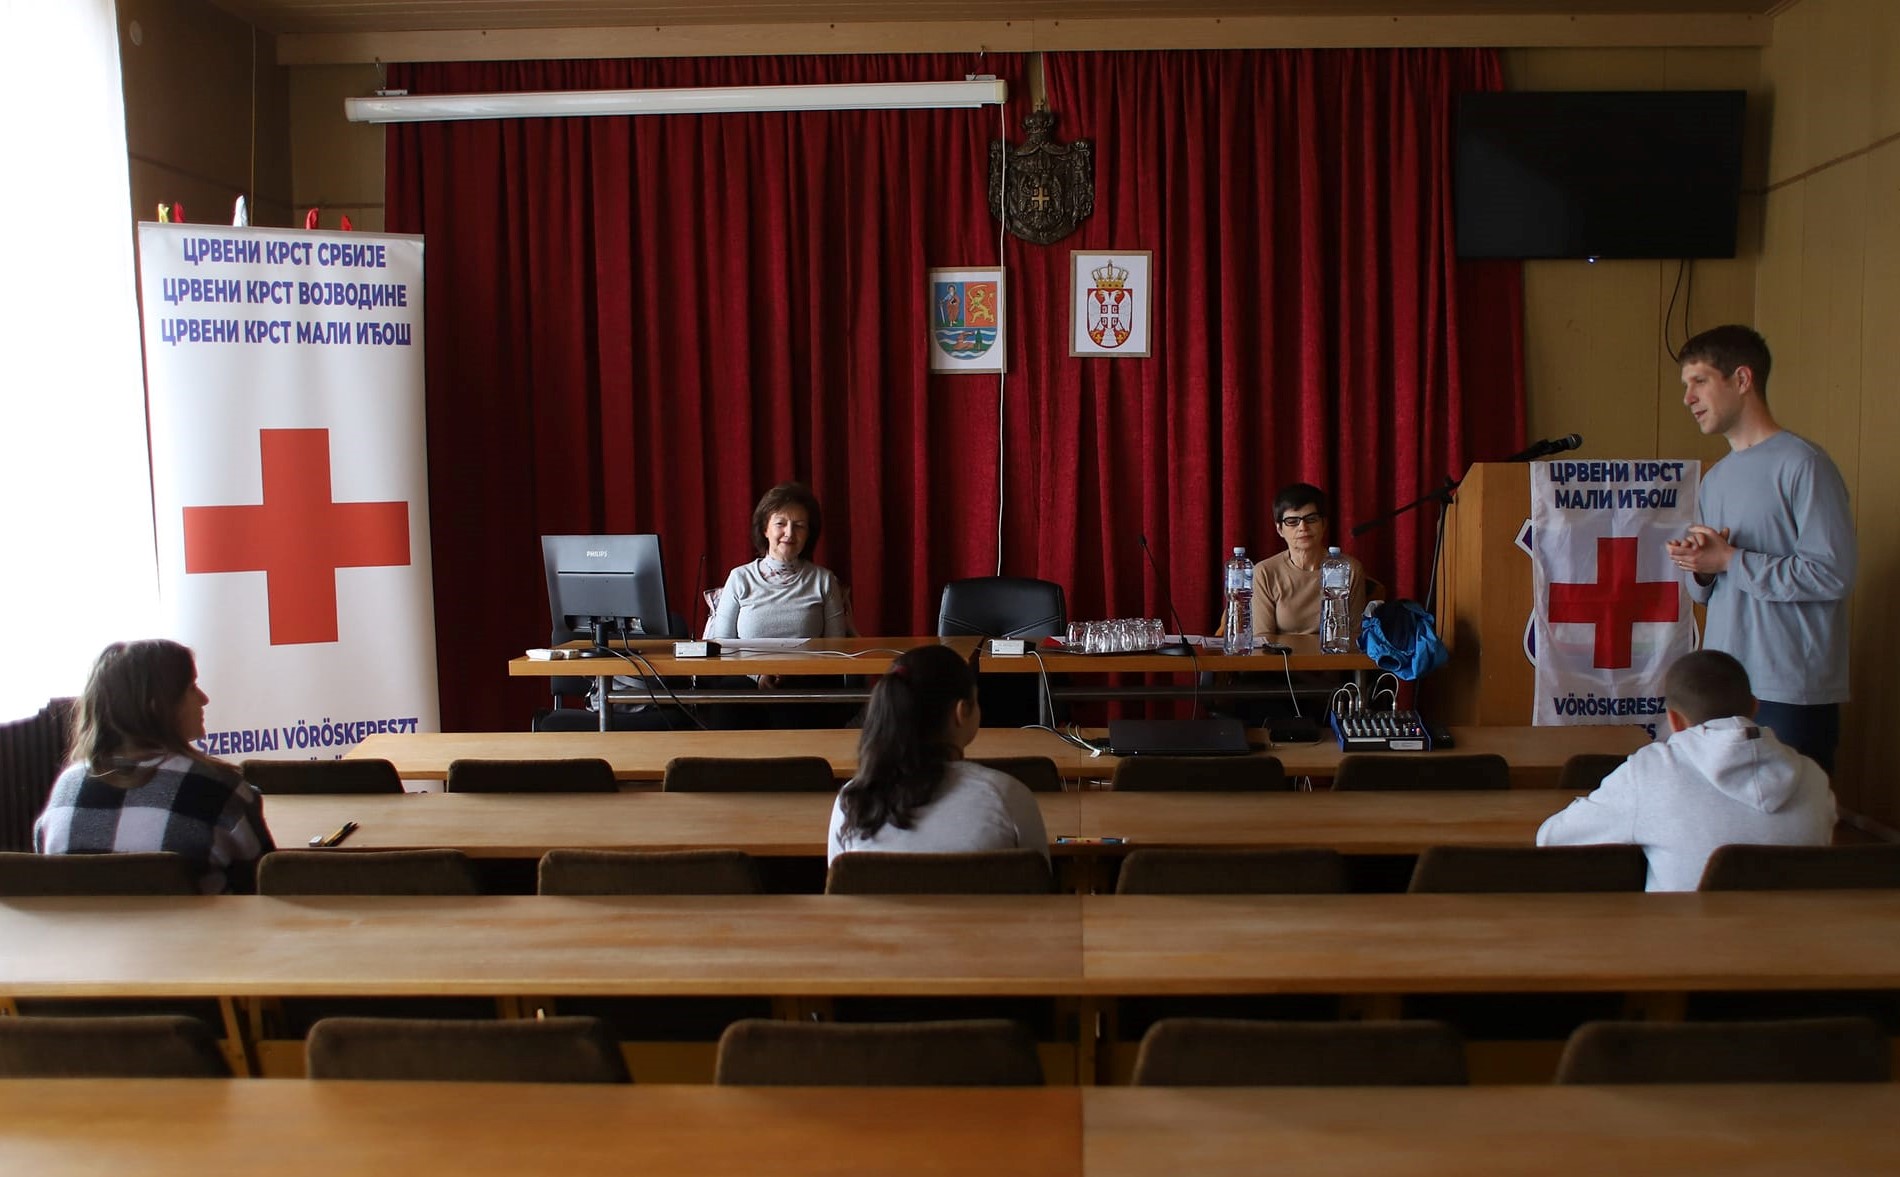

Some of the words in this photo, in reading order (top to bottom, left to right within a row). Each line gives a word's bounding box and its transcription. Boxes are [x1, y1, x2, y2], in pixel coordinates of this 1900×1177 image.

[183, 238, 261, 265] ЦРВЕНИ
[266, 241, 313, 265] КРСТ
[318, 243, 386, 268] СРБИЈЕ
[163, 278, 241, 306] ЦРВЕНИ
[247, 280, 293, 304] КРСТ
[299, 282, 407, 310] ВОЈВОДИНЕ
[161, 318, 239, 346] ЦРВЕНИ
[245, 320, 291, 344] КРСТ
[297, 321, 351, 345] МАЛИ
[357, 322, 412, 346] ИЂОШ
[1550, 462, 1629, 485] ЦРВЕНИ
[1634, 462, 1684, 482] КРСТ
[1555, 489, 1613, 510] МАЛИ
[1618, 488, 1677, 509] ИЂОШ
[586, 550, 608, 558] PHILIPS
[1553, 693, 1666, 716] VÖRÖSKERESZ
